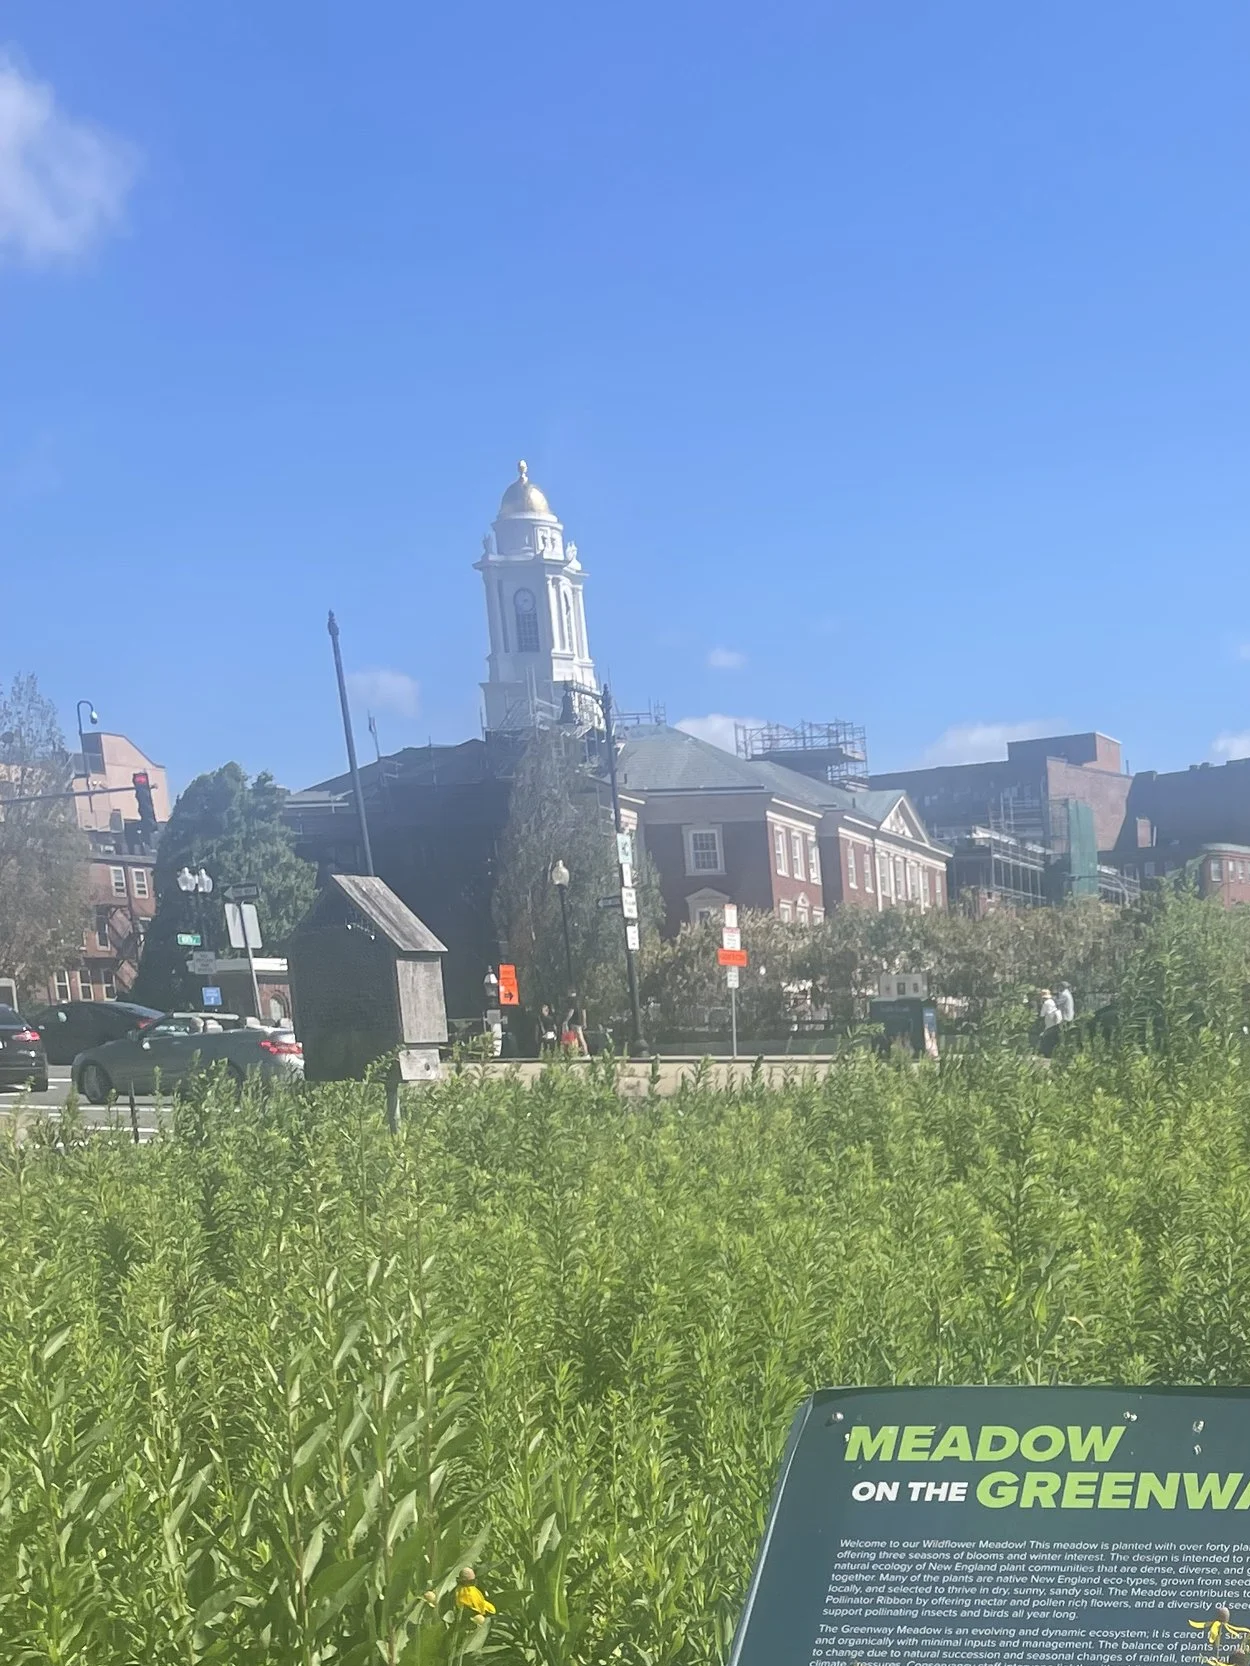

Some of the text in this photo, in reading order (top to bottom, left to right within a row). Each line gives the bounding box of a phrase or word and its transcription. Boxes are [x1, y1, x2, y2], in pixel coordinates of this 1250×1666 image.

[844, 1425, 1126, 1461] MEADOW
[852, 1481, 899, 1502] ON
[908, 1482, 968, 1502] THE
[840, 1539, 887, 1548] Welcome
[889, 1540, 900, 1548] to
[923, 1540, 976, 1548] Wildflower
[1031, 1541, 1050, 1549] This
[1053, 1541, 1098, 1550] meadow
[1101, 1542, 1109, 1550] is
[1112, 1542, 1152, 1551] planted
[1155, 1542, 1176, 1550] with
[1206, 1542, 1230, 1553] forty
[837, 1550, 876, 1561] offering
[879, 1551, 906, 1559] three
[953, 1551, 965, 1560] of
[966, 1551, 1004, 1560] blooms
[1006, 1552, 1027, 1560] and
[1029, 1552, 1062, 1560] winter
[1111, 1553, 1129, 1561] The
[1132, 1553, 1168, 1564] design
[1171, 1554, 1179, 1562] is
[1182, 1554, 1230, 1563] intended
[1233, 1555, 1243, 1563] to
[834, 1562, 870, 1570] natural
[871, 1562, 913, 1572] ecology
[915, 1562, 927, 1570] of
[928, 1562, 952, 1571] New
[954, 1562, 997, 1573] England
[999, 1563, 1026, 1573] plant
[1028, 1564, 1094, 1572] communities
[1097, 1564, 1117, 1573] that
[1223, 1566, 1244, 1574] and
[879, 1573, 908, 1583] Many
[910, 1573, 921, 1582] of
[923, 1574, 940, 1582] the
[942, 1574, 973, 1584] plants
[996, 1575, 1028, 1583] native
[1030, 1575, 1055, 1583] New
[1057, 1575, 1101, 1586] England
[1161, 1578, 1194, 1587] grown
[1197, 1577, 1222, 1585] from
[1225, 1578, 1250, 1586] seed
[865, 1585, 886, 1593] and
[888, 1585, 932, 1594] selected
[934, 1586, 945, 1594] to
[948, 1585, 977, 1594] thrive
[979, 1586, 989, 1594] in
[1049, 1587, 1082, 1597] sandy
[1108, 1587, 1128, 1596] The
[1131, 1588, 1177, 1597] Meadow
[1179, 1589, 1240, 1597] contributes
[825, 1595, 874, 1604] Pollinator
[876, 1596, 913, 1605] Ribbon
[916, 1596, 929, 1607] by
[931, 1597, 972, 1607] offering
[974, 1598, 1008, 1606] nectar
[1009, 1598, 1030, 1606] and
[1032, 1598, 1065, 1608] pollen
[1068, 1599, 1088, 1608] rich
[1134, 1600, 1155, 1608] and
[1167, 1600, 1212, 1611] diversity
[1215, 1600, 1227, 1609] of
[822, 1608, 863, 1617] support
[864, 1608, 919, 1618] pollinating
[921, 1608, 958, 1617] insects
[960, 1609, 981, 1617] and
[983, 1609, 1009, 1617] birds
[1012, 1609, 1024, 1617] all
[1026, 1611, 1050, 1620] year
[820, 1624, 838, 1633] The
[841, 1625, 895, 1636] Greenway
[896, 1625, 942, 1634] Meadow
[944, 1627, 953, 1635] is
[971, 1627, 1016, 1638] evolving
[1018, 1627, 1039, 1636] and
[1041, 1628, 1086, 1638] dynamic
[1152, 1629, 1159, 1638] it
[1162, 1630, 1170, 1638] is
[1173, 1630, 1204, 1639] cared
[815, 1636, 836, 1645] and
[838, 1637, 895, 1647] organically
[897, 1637, 918, 1645] with
[921, 1638, 962, 1646] minimal
[964, 1638, 996, 1648] inputs
[999, 1639, 1020, 1647] and
[1098, 1640, 1119, 1649] The
[1121, 1641, 1164, 1650] balance
[1167, 1642, 1179, 1650] of
[1180, 1641, 1213, 1652] plants
[812, 1648, 823, 1656] to
[825, 1648, 865, 1659] change
[867, 1649, 888, 1657] due
[903, 1650, 940, 1658] natural
[942, 1651, 1000, 1659] succession
[1003, 1651, 1024, 1659] and
[1026, 1652, 1074, 1660] seasonal
[1077, 1652, 1122, 1663] changes
[1125, 1653, 1137, 1662] of
